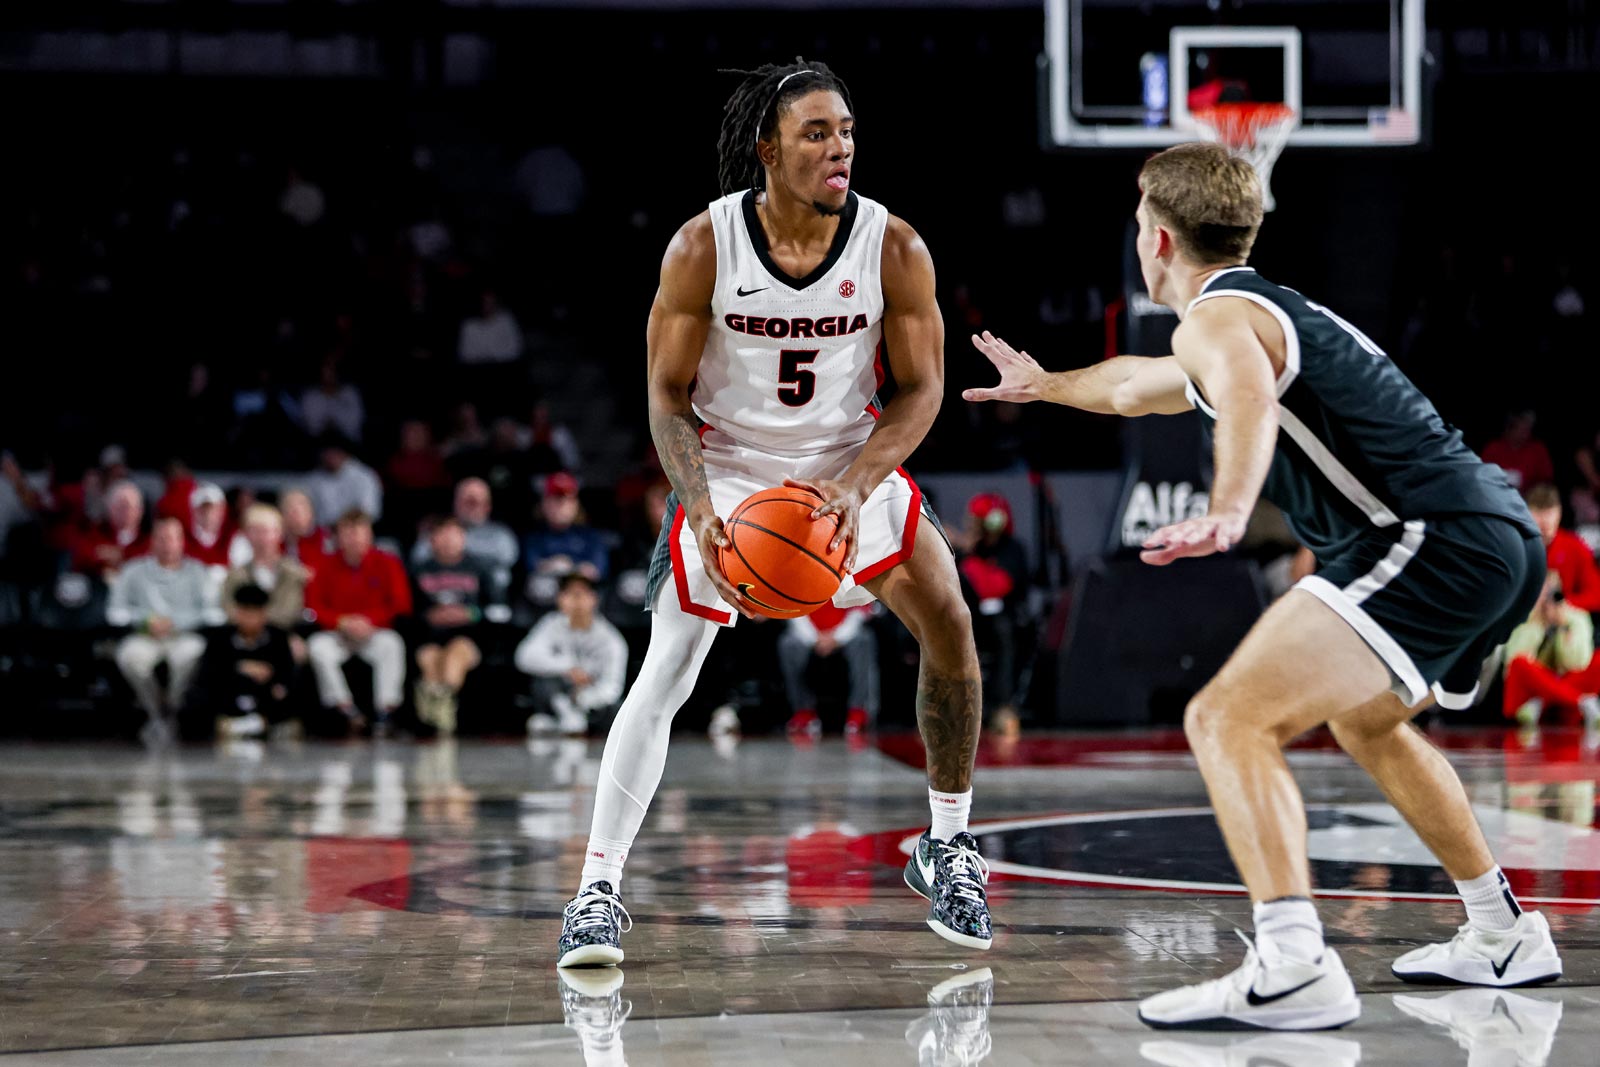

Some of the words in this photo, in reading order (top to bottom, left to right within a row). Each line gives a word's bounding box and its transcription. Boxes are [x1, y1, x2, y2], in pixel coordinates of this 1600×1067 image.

[840, 281, 854, 297] SEC
[724, 313, 868, 338] GEORGIA
[777, 349, 820, 408] 5
